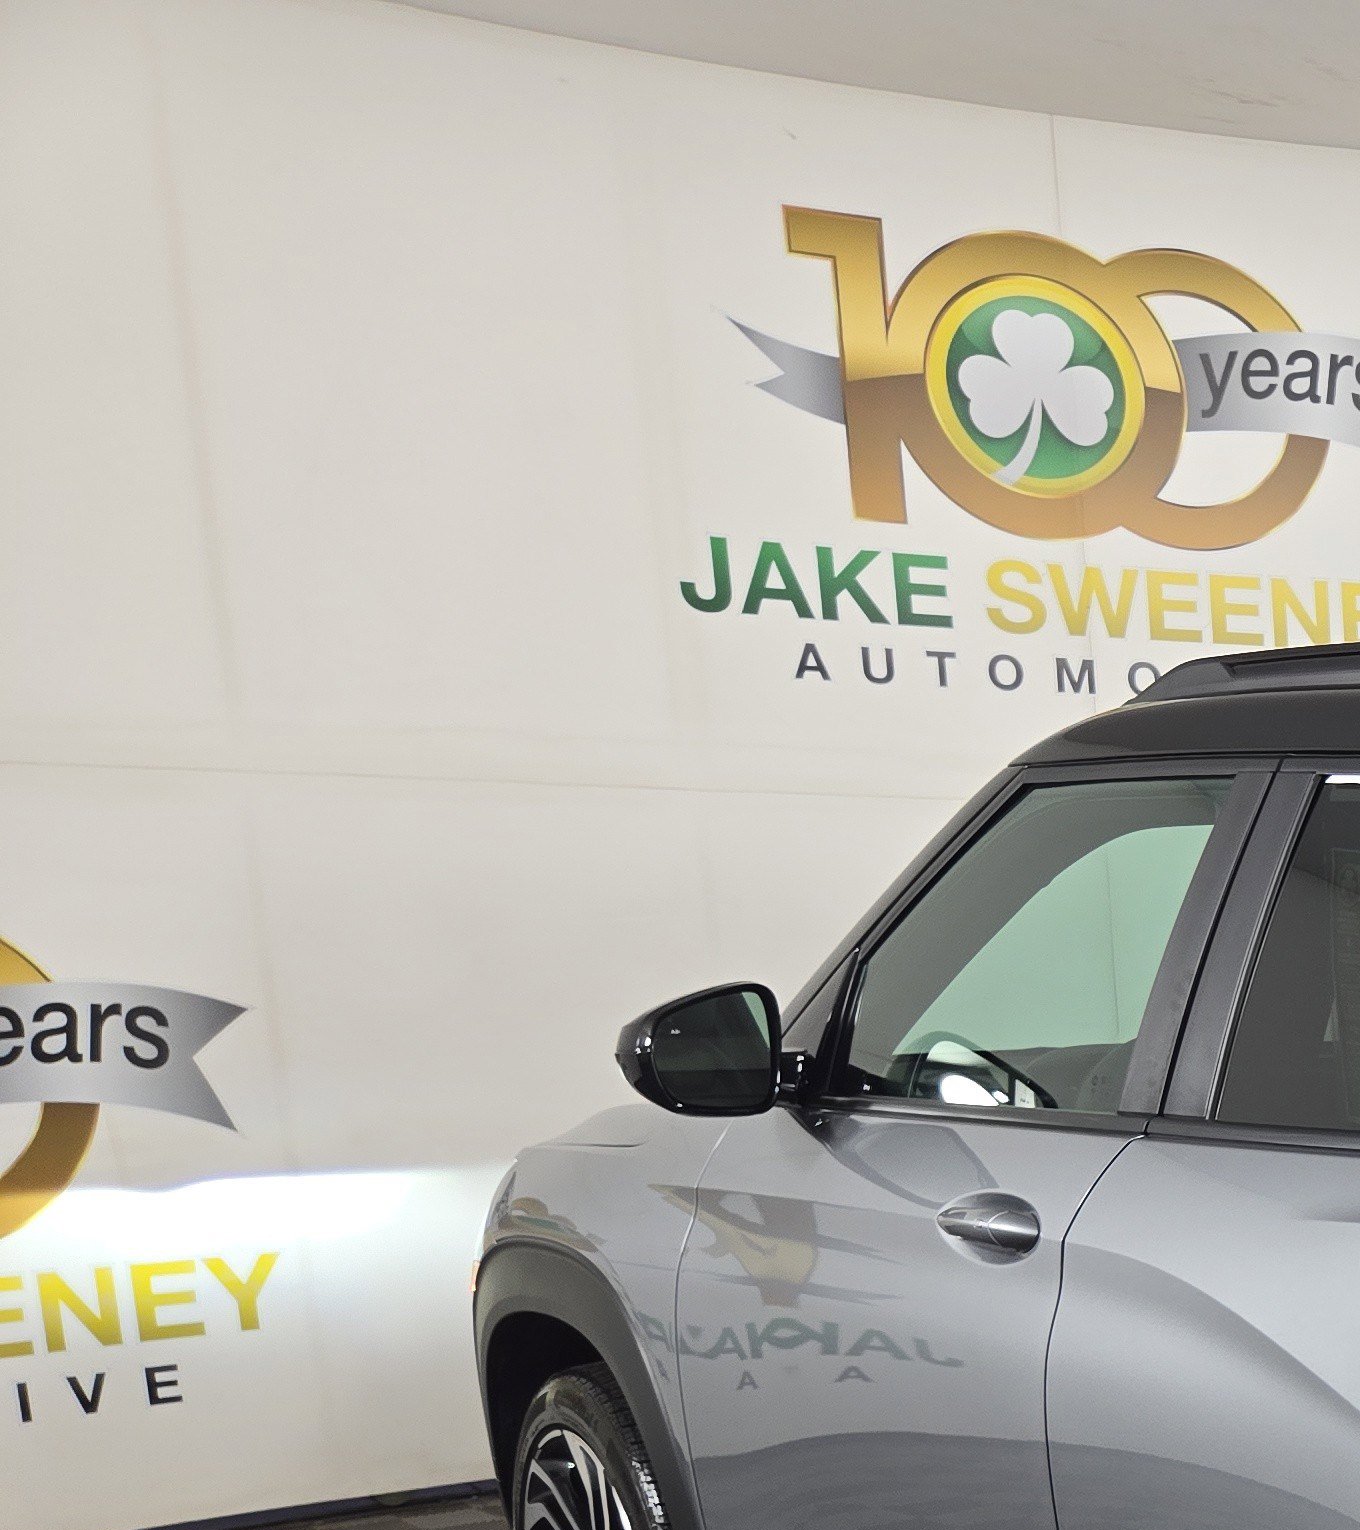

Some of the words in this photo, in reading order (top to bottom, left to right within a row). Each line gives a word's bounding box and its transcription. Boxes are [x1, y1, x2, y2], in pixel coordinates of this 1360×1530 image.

[781, 204, 1331, 550] 100
[681, 535, 953, 628] JAKE
[795, 642, 1160, 695] AUTOMO
